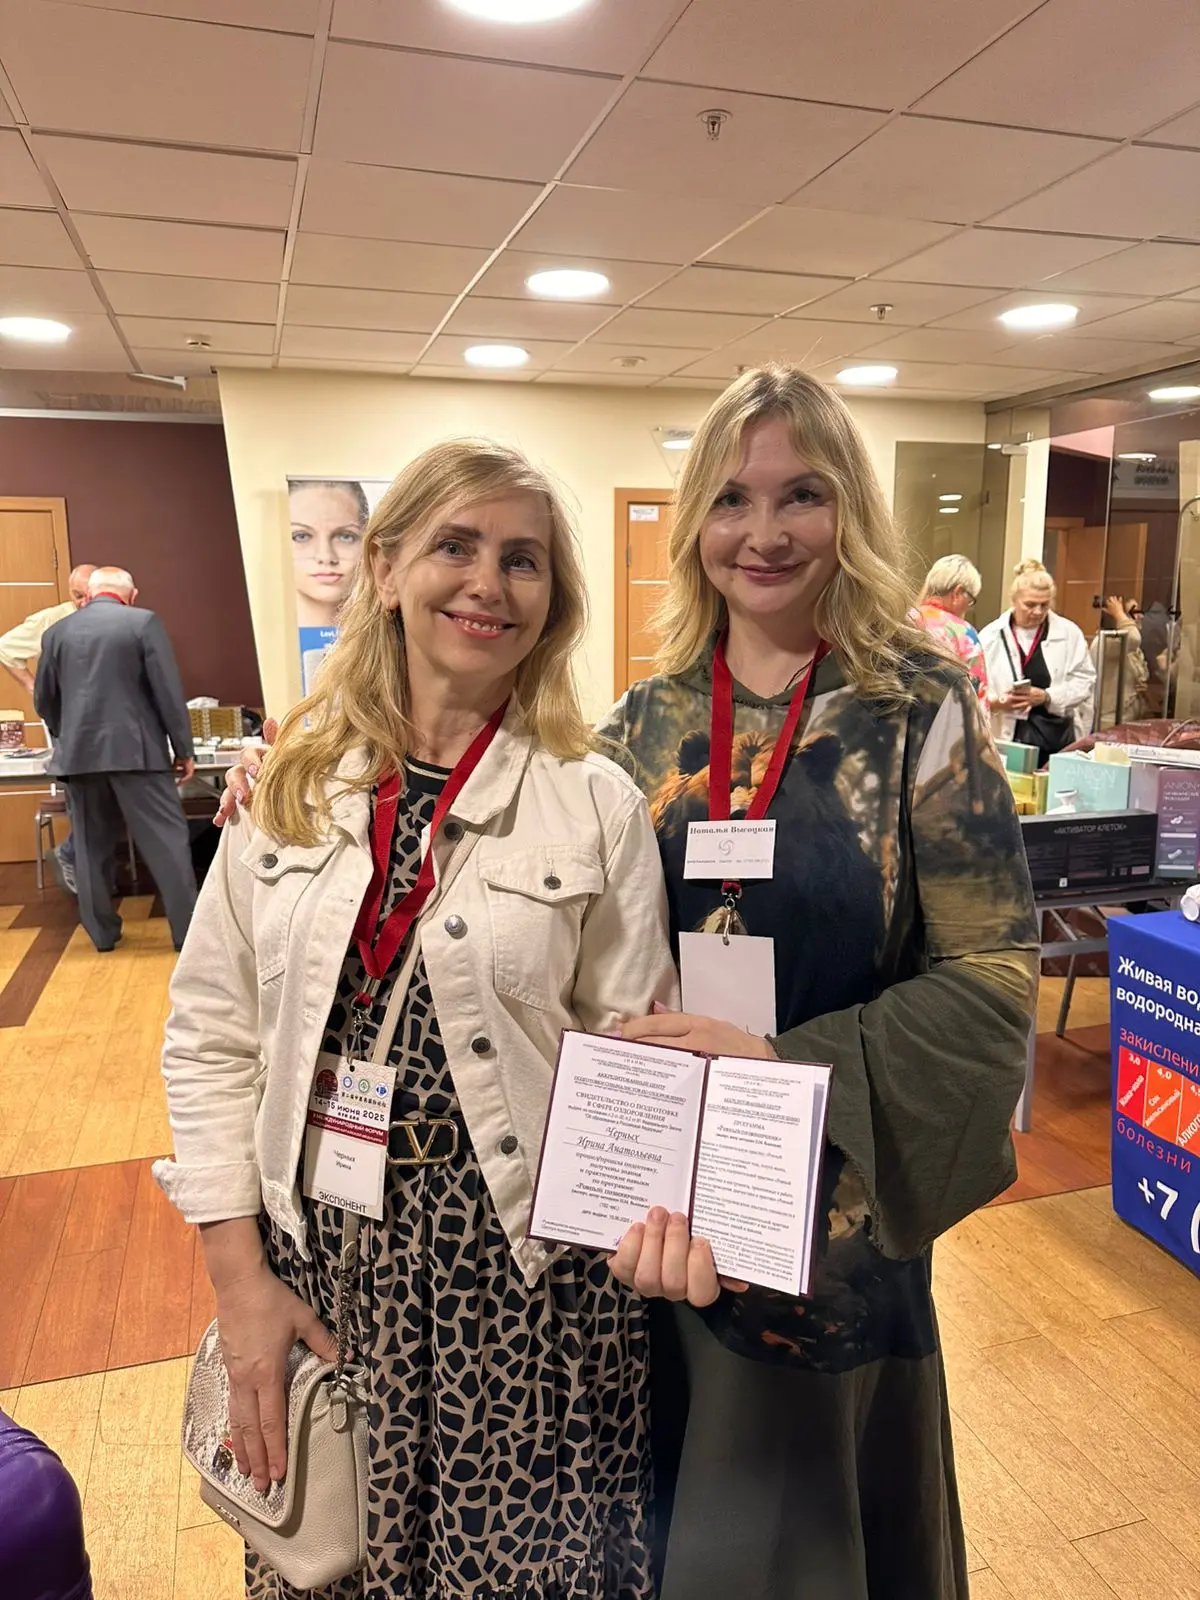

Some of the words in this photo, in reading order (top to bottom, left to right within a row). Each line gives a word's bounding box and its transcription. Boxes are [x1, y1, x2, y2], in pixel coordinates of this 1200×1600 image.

[1117, 956, 1173, 995] Живая
[1177, 985, 1200, 1011] во
[1157, 1067, 1173, 1080] 4,0
[575, 1091, 629, 1106] СВИДЕТЕЛЬСТВО
[362, 1110, 385, 1122] 2025
[604, 1126, 640, 1144] Черных
[575, 1135, 605, 1152] Ирина
[604, 1141, 662, 1162] Анатольевна
[1116, 1117, 1192, 1174] болезни
[318, 1191, 367, 1214] ЭКСПОНЕНТ
